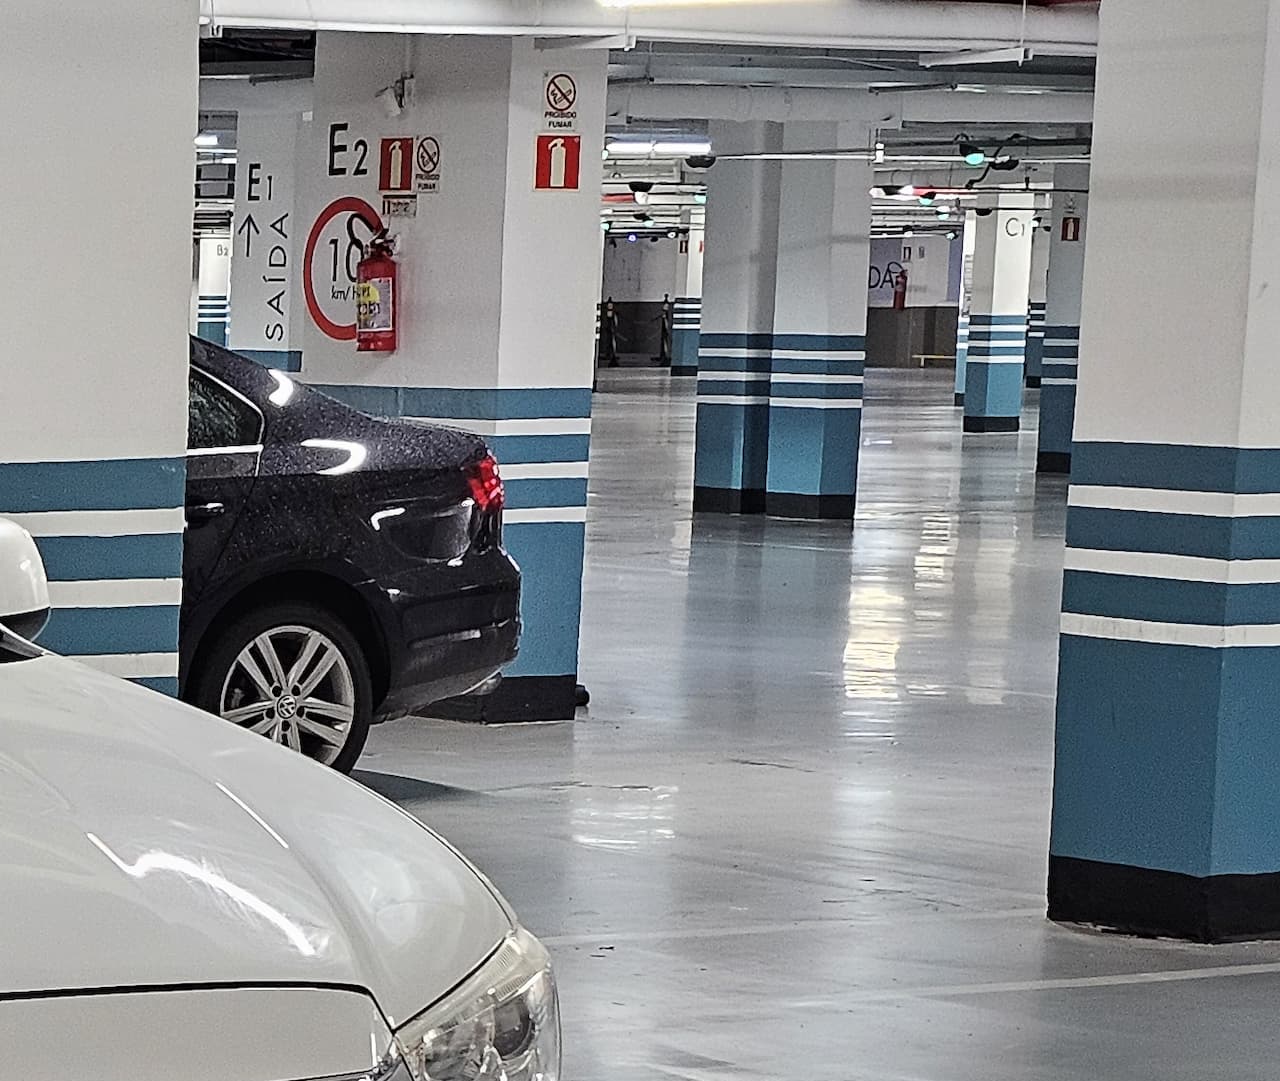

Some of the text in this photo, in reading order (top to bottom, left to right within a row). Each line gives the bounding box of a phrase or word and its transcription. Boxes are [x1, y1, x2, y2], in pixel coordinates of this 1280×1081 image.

[329, 123, 368, 176] E2
[248, 164, 273, 201] E1
[262, 213, 289, 342] SAÍDA
[329, 238, 365, 283] 10
